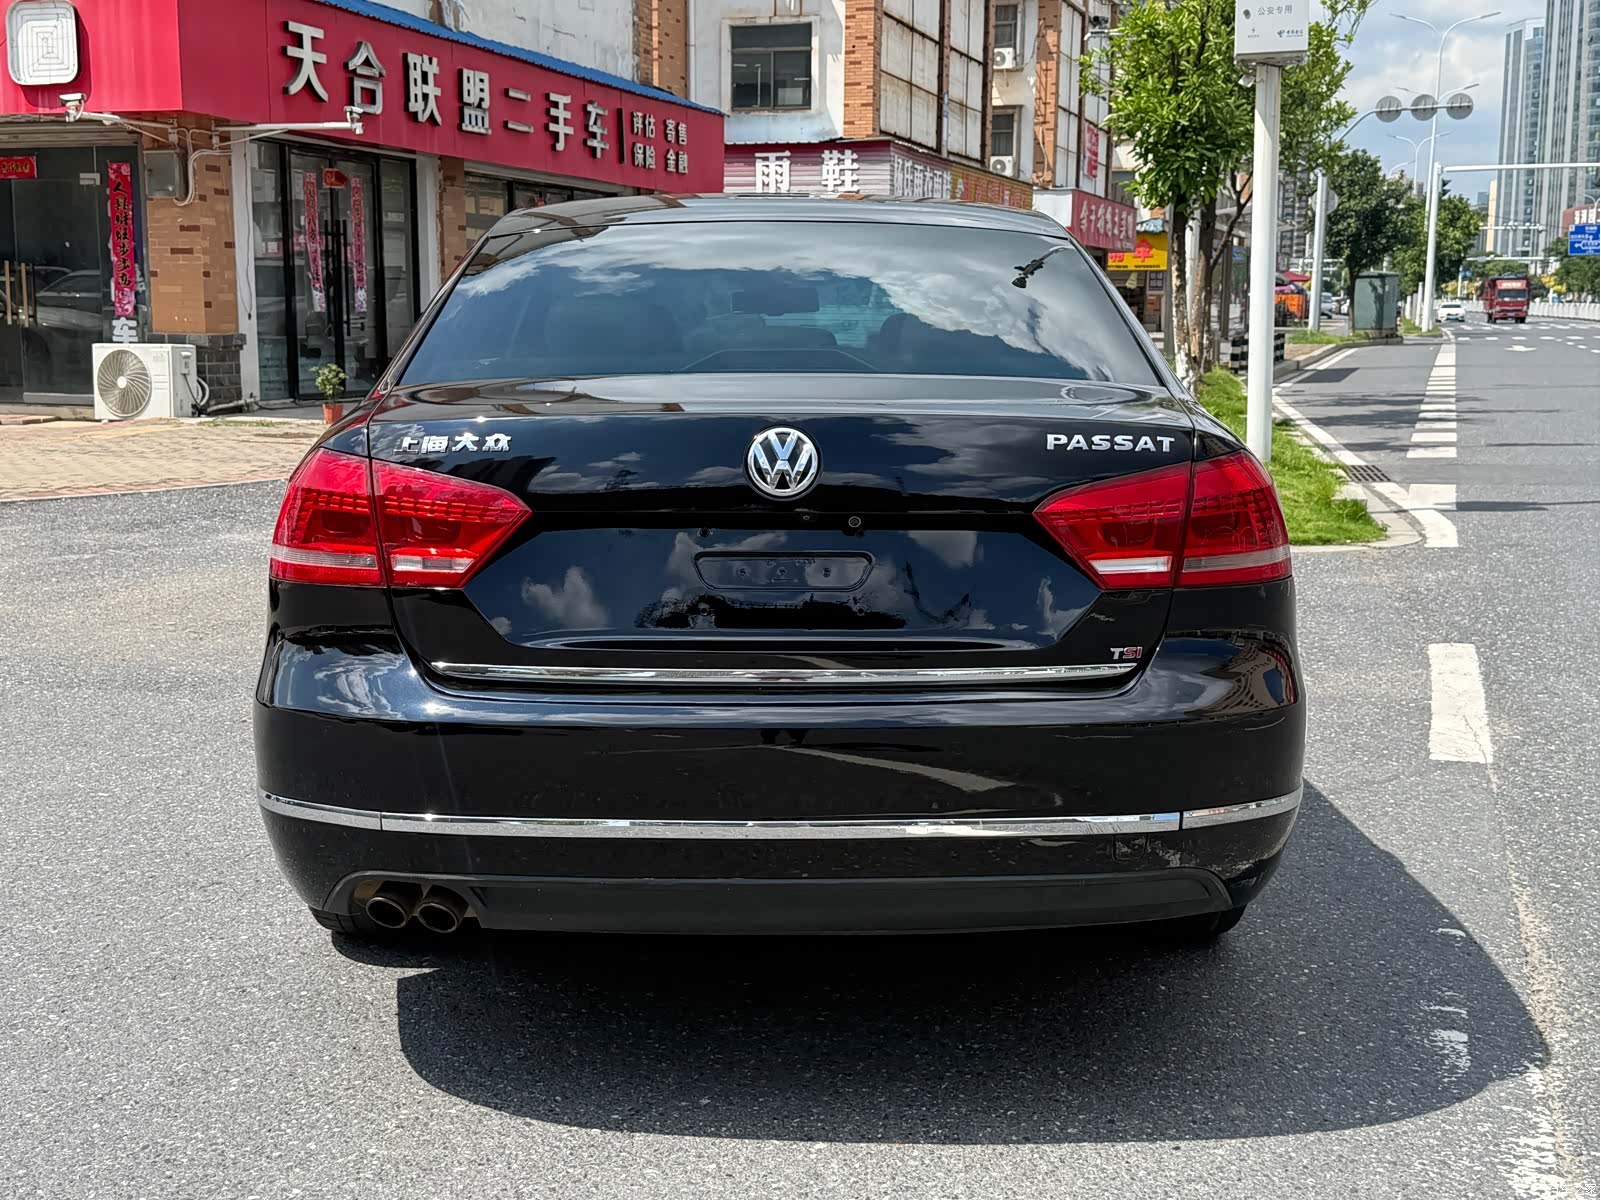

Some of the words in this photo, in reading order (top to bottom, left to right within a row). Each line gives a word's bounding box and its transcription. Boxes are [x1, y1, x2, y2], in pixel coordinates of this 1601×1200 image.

[1257, 5, 1293, 16] 公安专用
[284, 20, 610, 160] 天合联盟二手车
[632, 111, 656, 138] 评估
[666, 119, 688, 146] 寄售
[634, 143, 656, 169] 保险
[667, 148, 688, 174] 金融
[754, 149, 860, 193] 雨鞋
[394, 432, 512, 454] 上海大众
[1046, 433, 1175, 453] PASSAT
[1110, 646, 1143, 660] TSI
